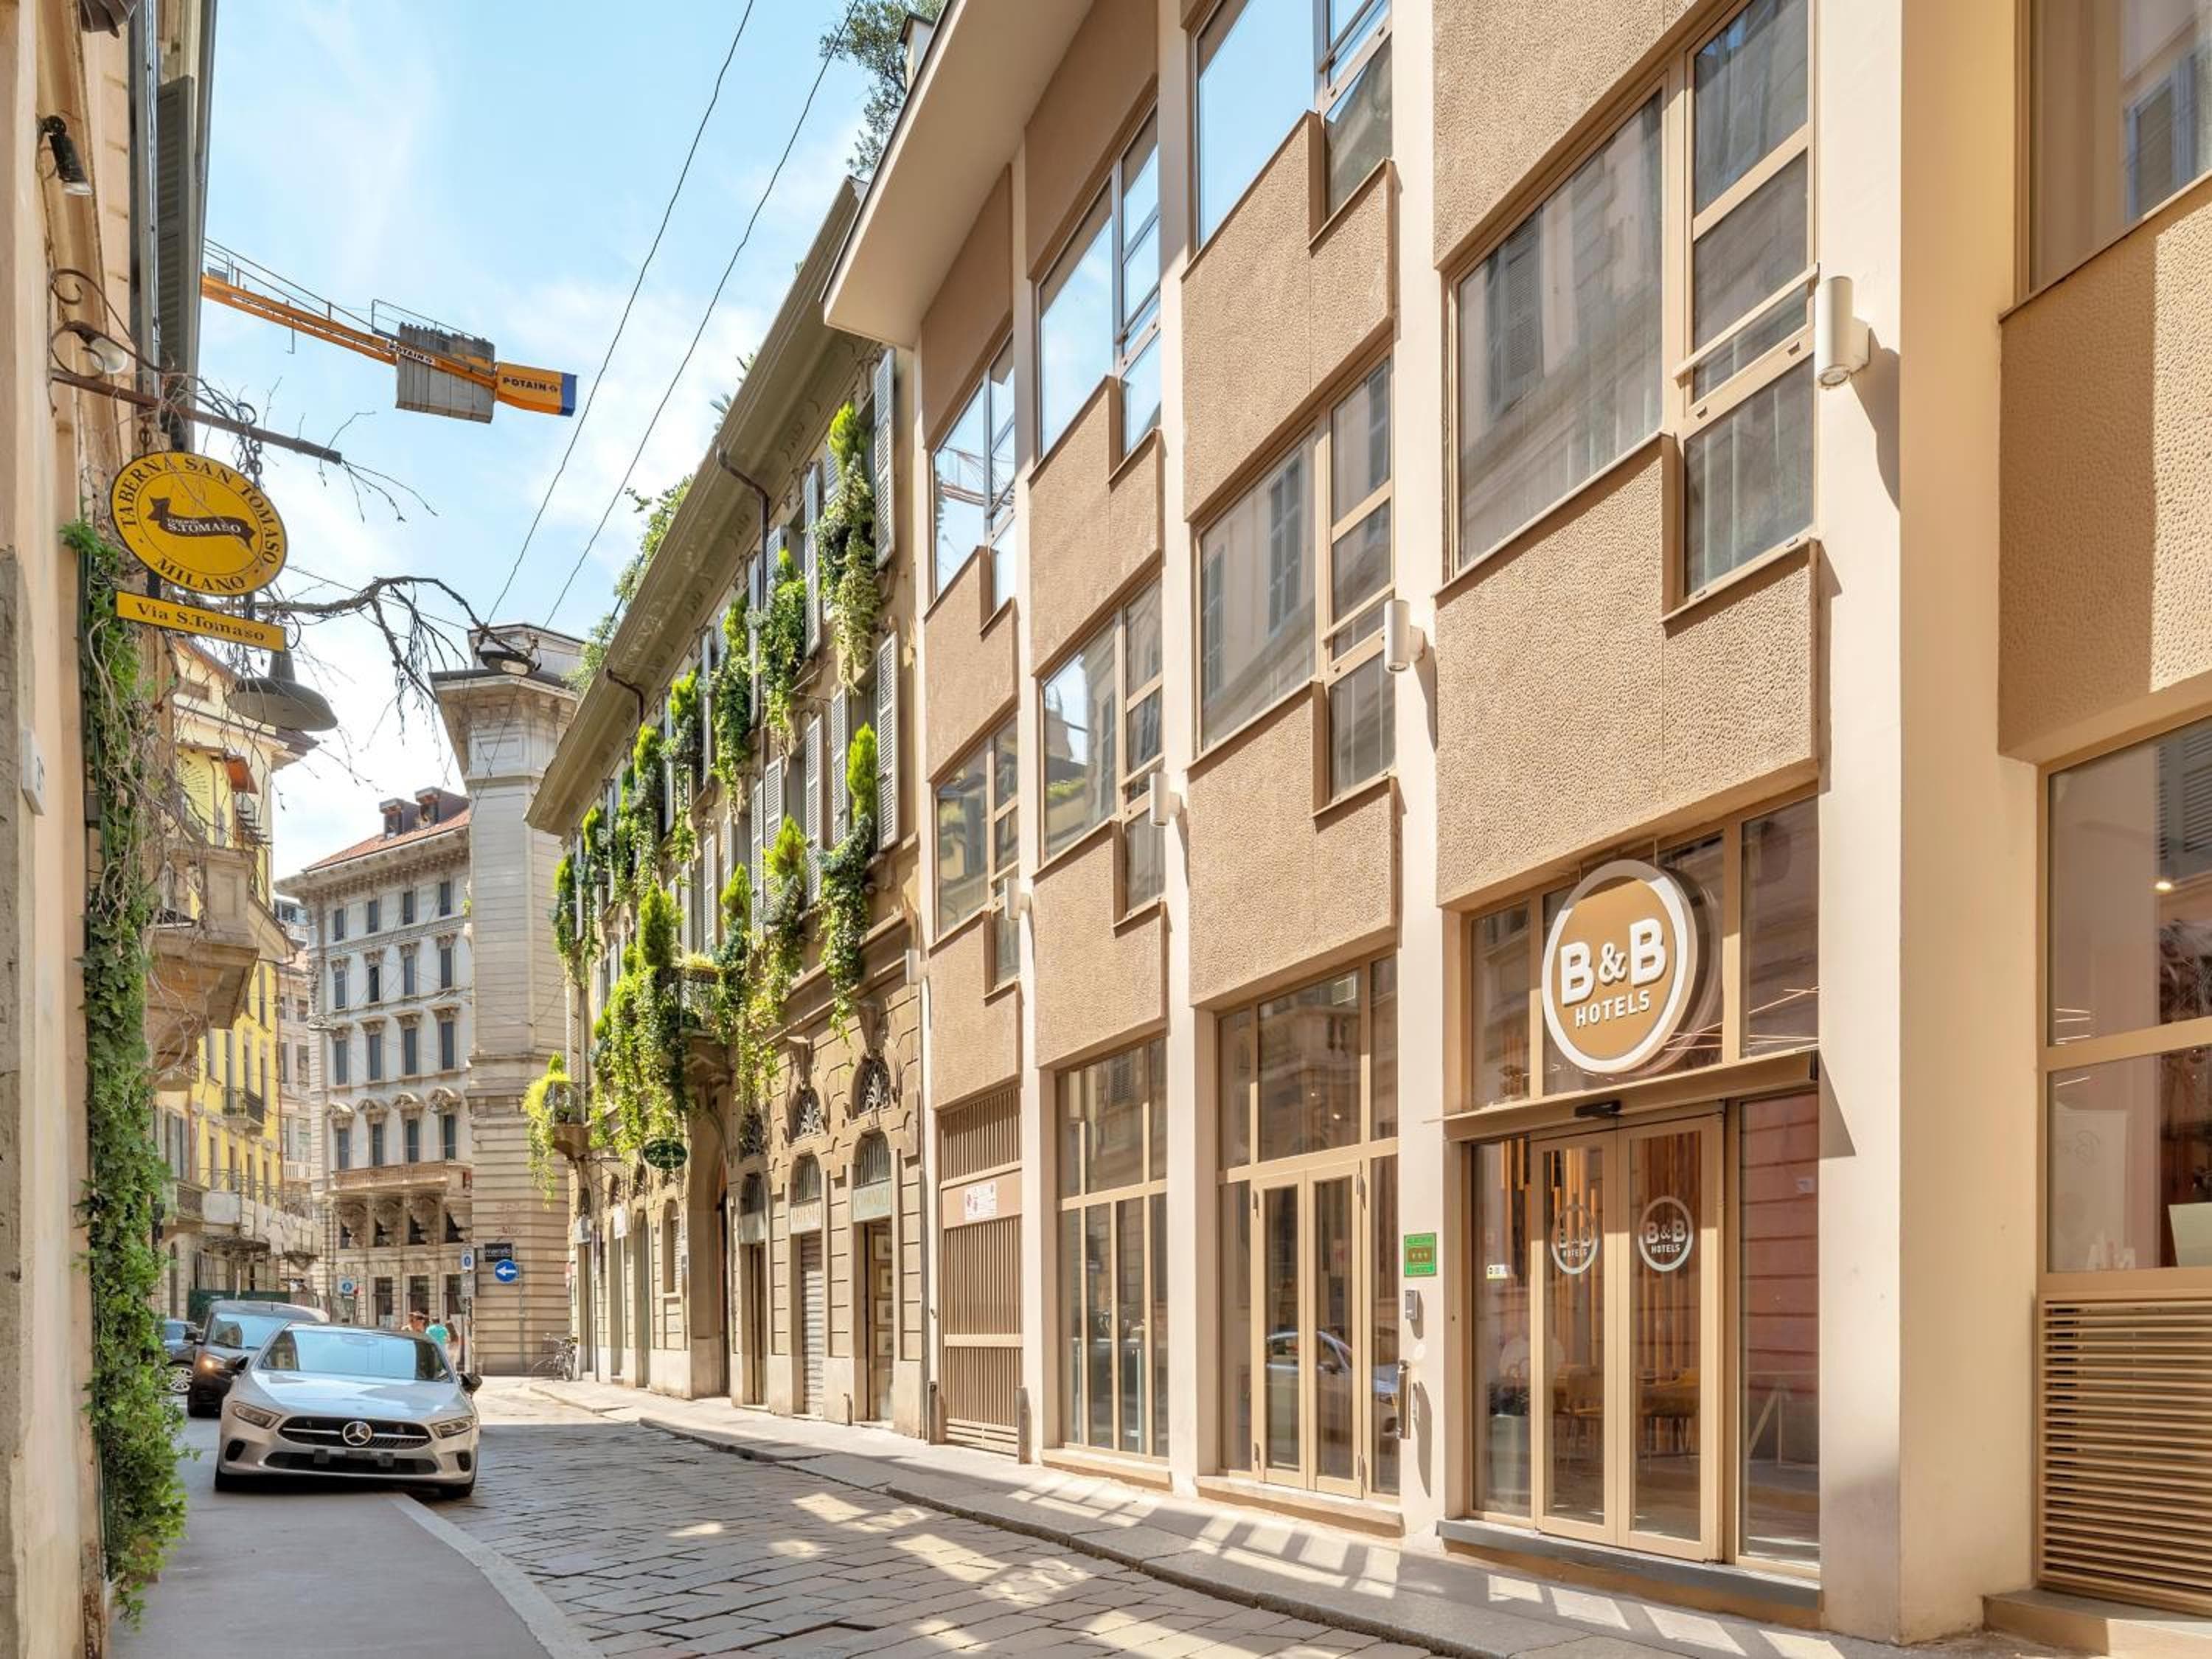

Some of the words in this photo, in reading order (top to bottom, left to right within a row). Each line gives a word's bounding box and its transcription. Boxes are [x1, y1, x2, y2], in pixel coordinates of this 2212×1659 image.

[389, 344, 424, 361] POTAIN
[503, 377, 546, 391] POTAIN
[118, 458, 177, 528] TABERNA
[184, 457, 232, 484] SAN
[238, 484, 280, 565] TOMASO
[155, 557, 246, 590] MILANO
[136, 602, 169, 619] Via
[176, 611, 265, 641] S.Tomaso
[1560, 918, 1666, 1005] B&B
[1576, 990, 1651, 1027] HOTELS
[1646, 1220, 1686, 1244] B&B
[1651, 1244, 1680, 1253] HOTELS
